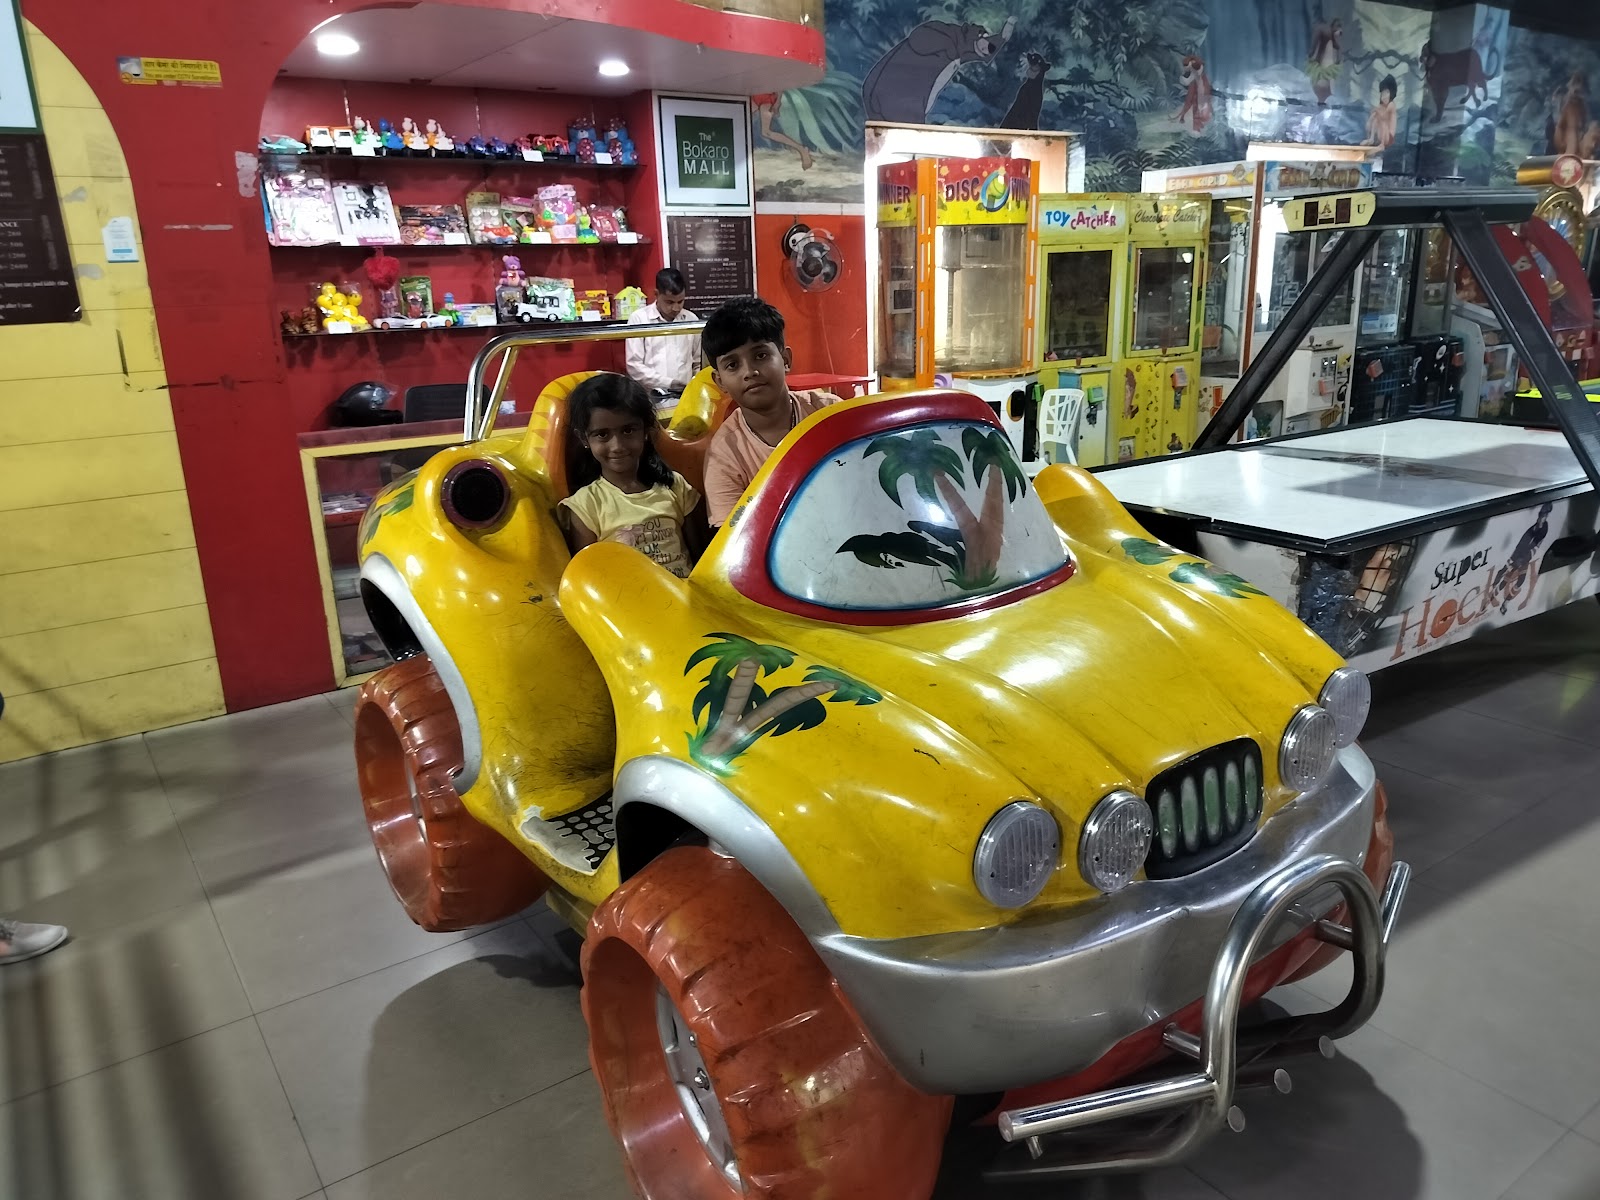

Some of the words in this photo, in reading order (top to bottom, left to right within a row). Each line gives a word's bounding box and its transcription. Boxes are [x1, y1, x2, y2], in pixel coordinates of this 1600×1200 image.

[698, 132, 712, 142] The
[682, 140, 730, 158] Bokaro
[684, 159, 730, 176] MALL
[1070, 210, 1116, 230] CATCHER
[1430, 546, 1492, 590] Super
[1389, 558, 1540, 662] Hockey
